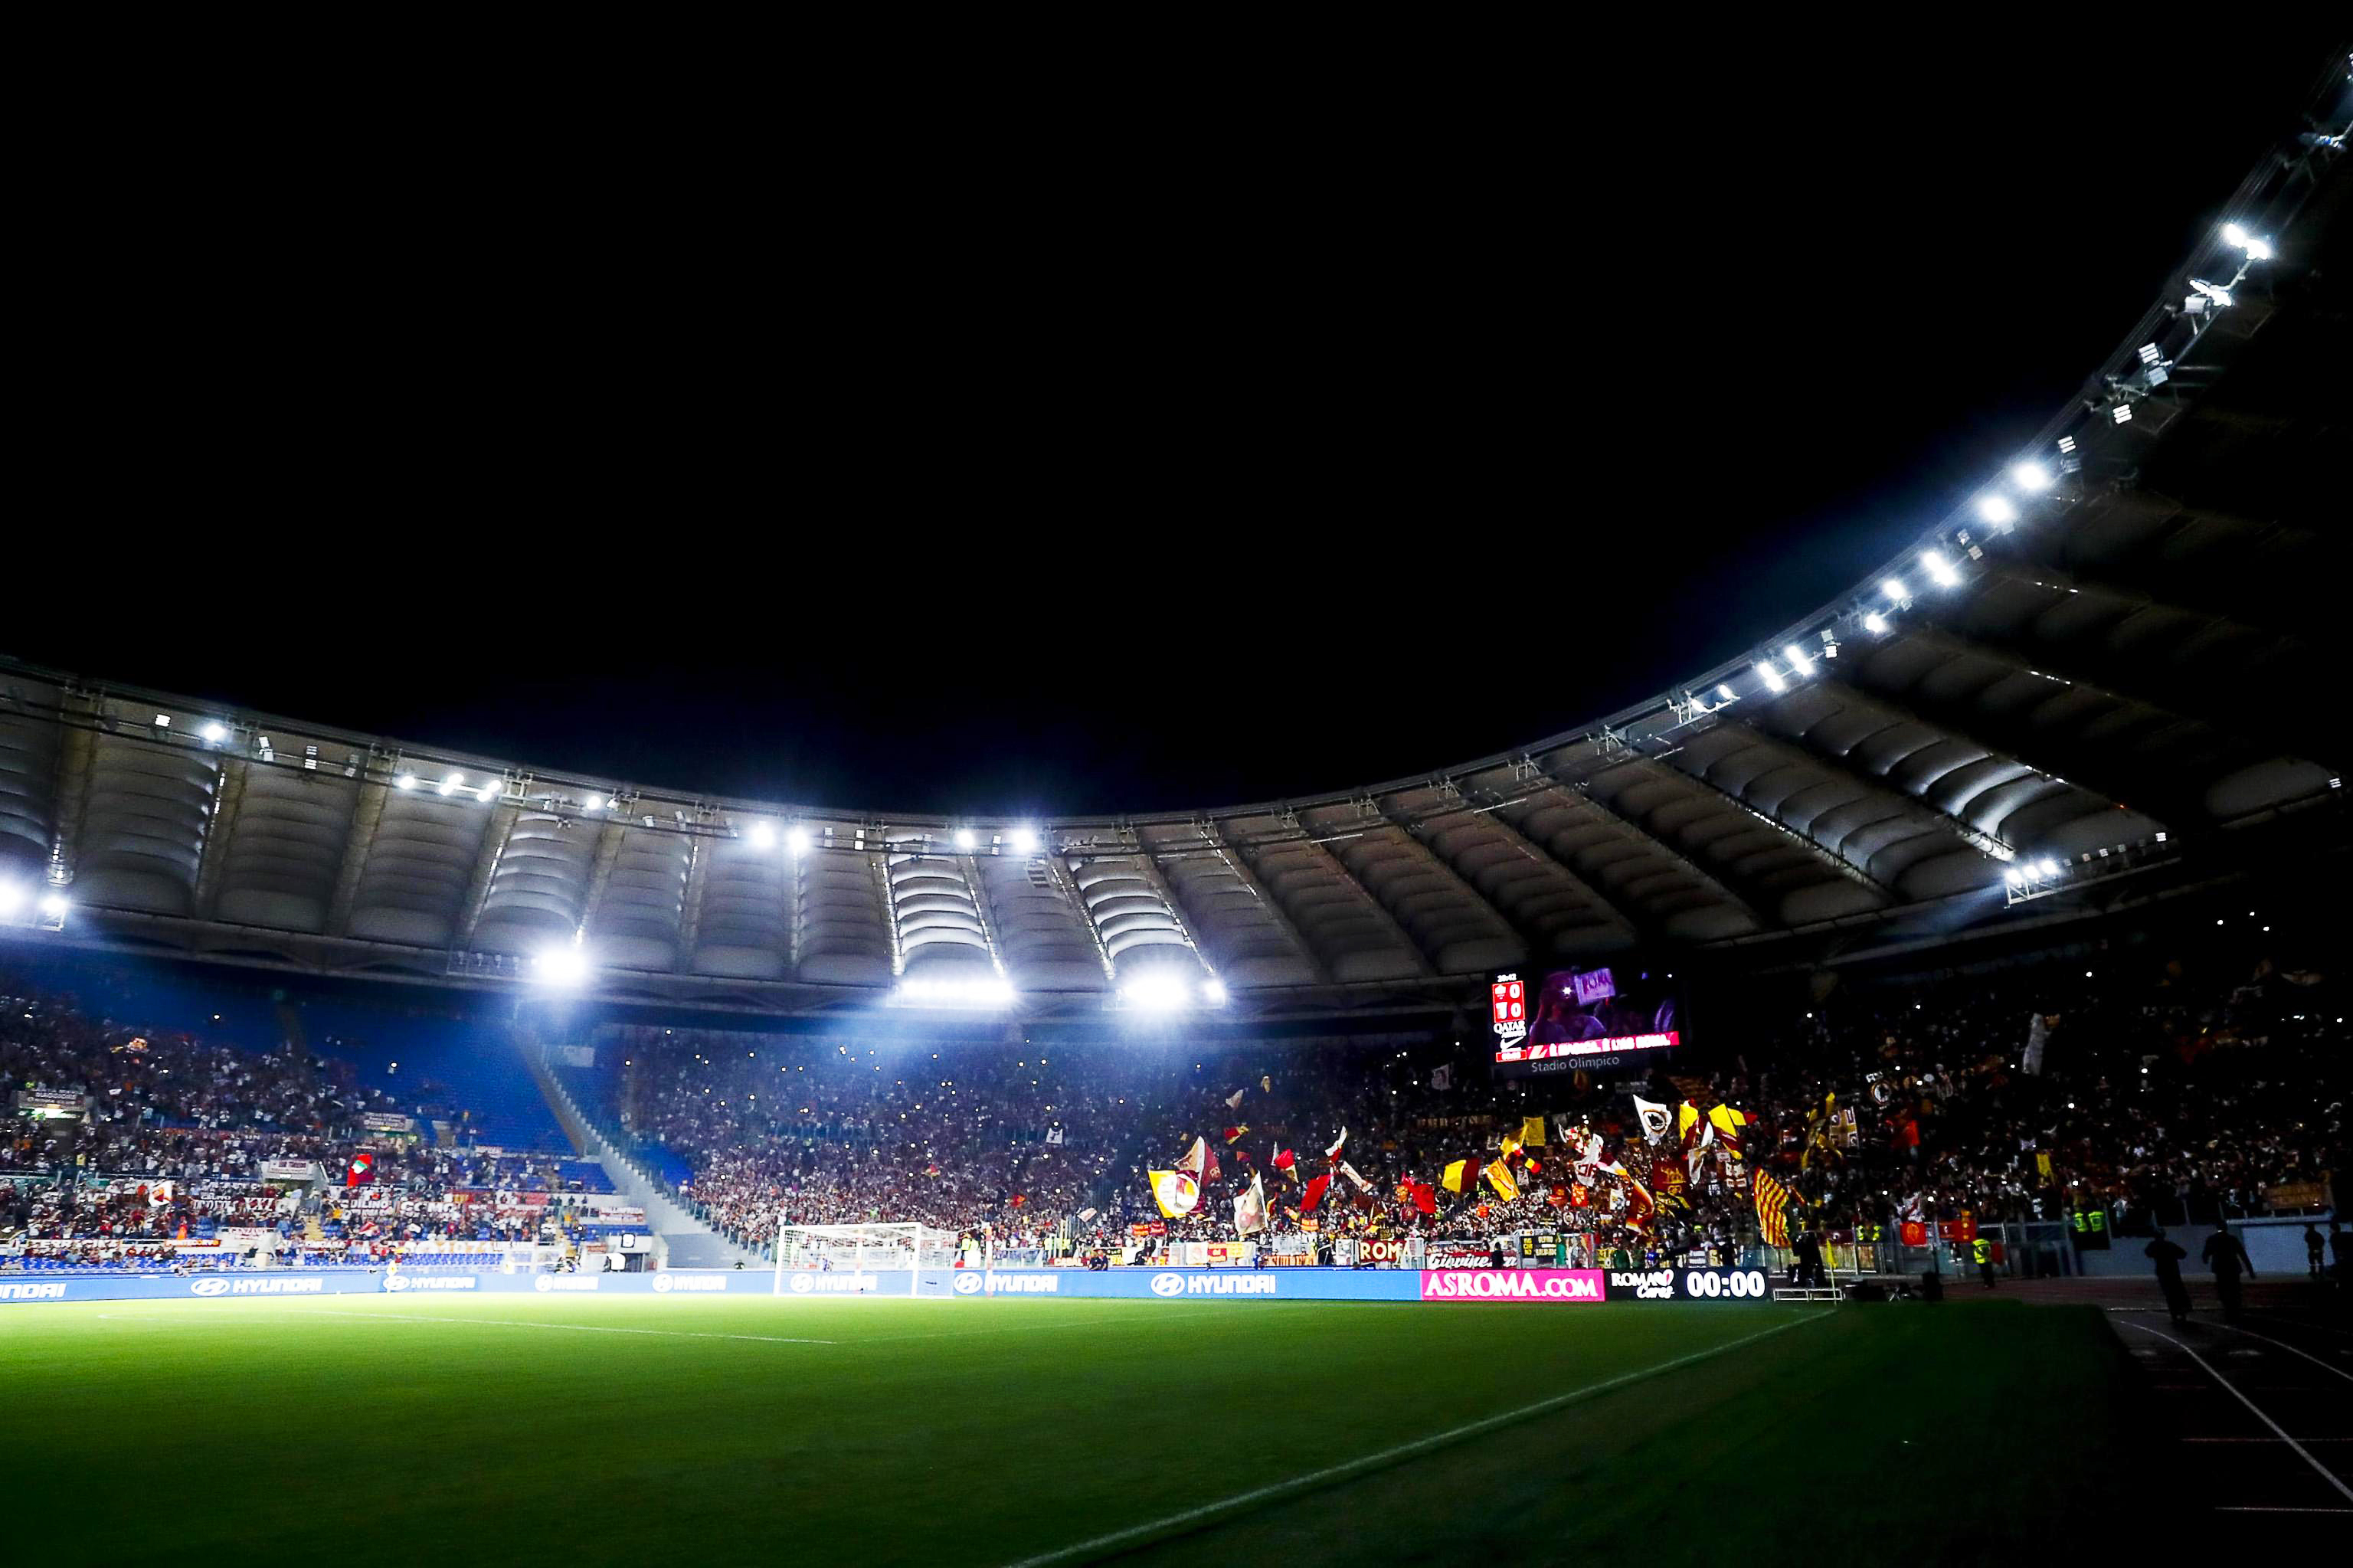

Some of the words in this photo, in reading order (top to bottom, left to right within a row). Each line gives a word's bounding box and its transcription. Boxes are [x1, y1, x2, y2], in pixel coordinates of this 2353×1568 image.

[1510, 984, 1520, 998] 0
[1511, 1003, 1521, 1017] 0
[1494, 1020, 1525, 1035] QATAR
[1532, 1060, 1567, 1072] Stadio
[1569, 1056, 1619, 1069] Olimpico
[1360, 1242, 1411, 1260] ROMA
[0, 1283, 67, 1299] NDAI
[233, 1278, 323, 1294] HYUNDAI
[1187, 1275, 1276, 1294] HYUNDAI
[1425, 1272, 1598, 1297] ASROMA.COM
[1687, 1271, 1766, 1297] 00:00
